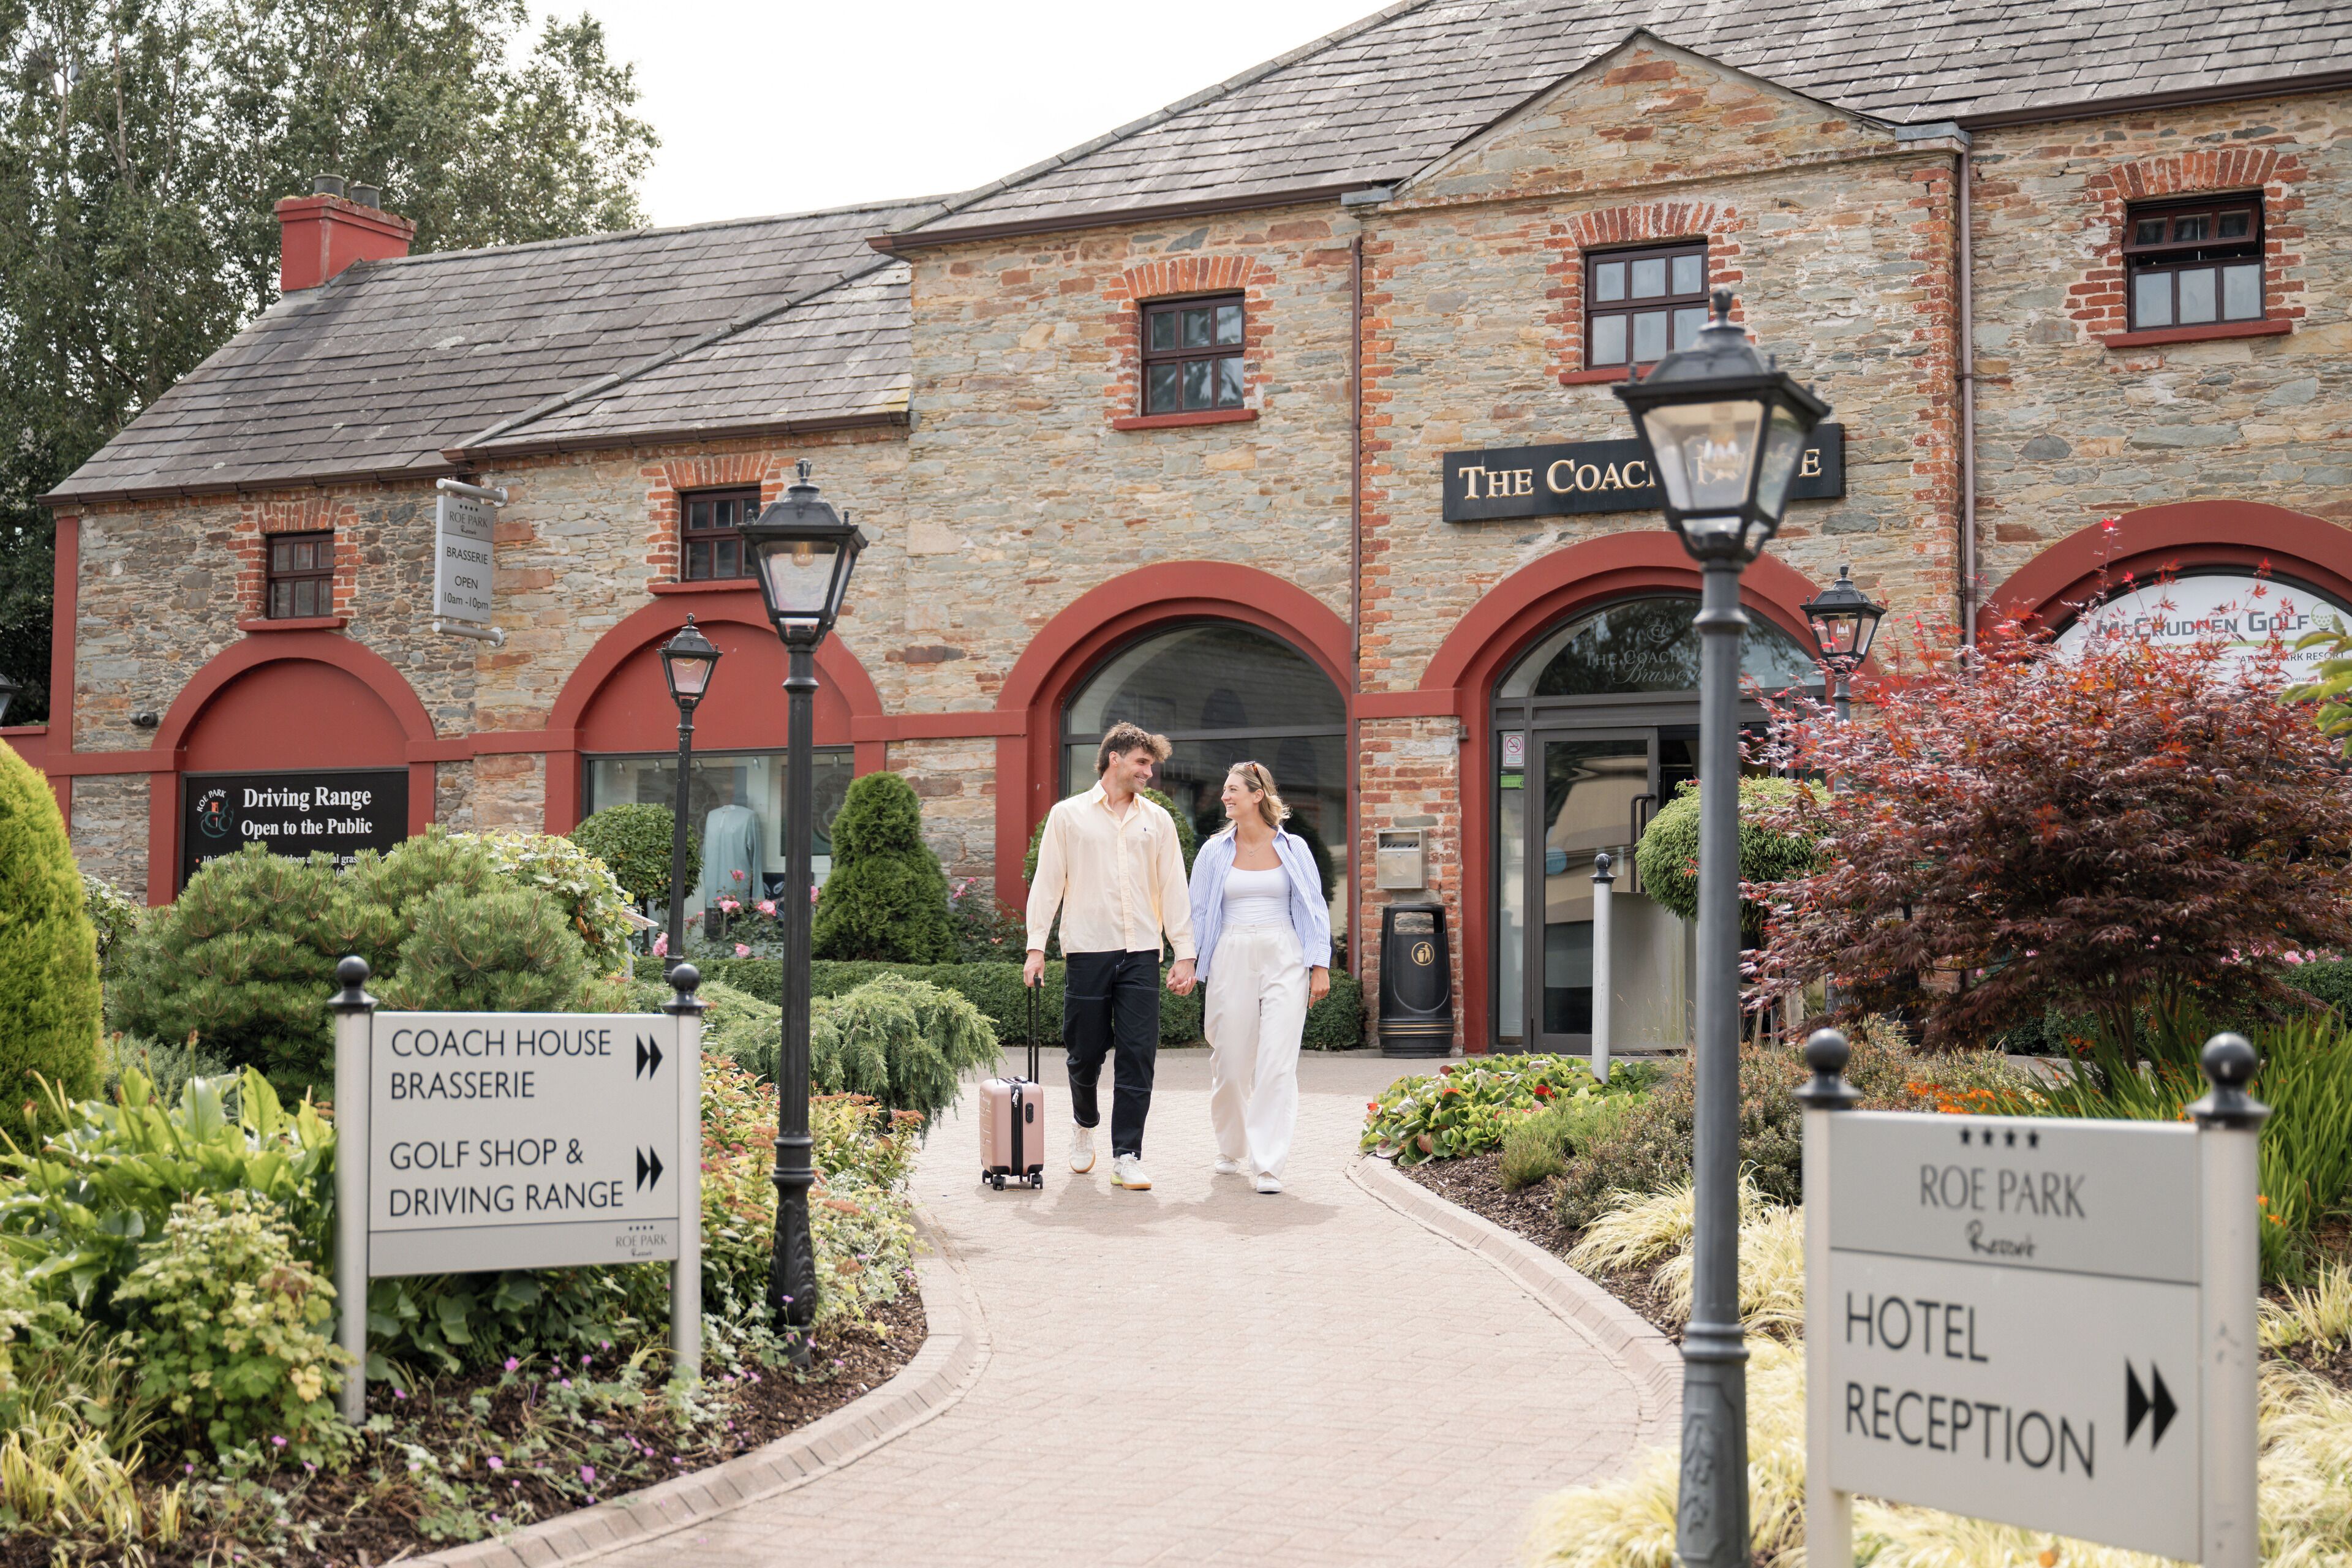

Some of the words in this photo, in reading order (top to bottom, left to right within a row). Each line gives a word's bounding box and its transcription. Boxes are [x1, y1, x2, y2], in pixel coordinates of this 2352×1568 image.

[1458, 466, 1534, 500] THE
[450, 511, 466, 524] ROE
[468, 514, 488, 528] PARK
[447, 546, 488, 565] BRASSERIE
[454, 576, 478, 589] OPEN
[444, 592, 462, 605] 10am
[2248, 611, 2309, 632] GOLF
[1623, 649, 1678, 665] COACH
[197, 795, 208, 812] ROE
[208, 789, 227, 799] PARK
[243, 788, 310, 812] Driving
[314, 786, 372, 810] Range
[241, 820, 279, 840] Open
[283, 820, 296, 835] to
[301, 820, 323, 835] the
[327, 818, 372, 834] Public
[392, 1029, 505, 1057] COACH
[516, 1029, 611, 1057] HOUSE
[391, 1071, 535, 1099] BRASSERIE
[390, 1140, 470, 1170] GOLF
[480, 1138, 557, 1167] SHOP
[566, 1138, 584, 1164] &
[390, 1183, 514, 1216] DRIVING
[526, 1180, 624, 1211] RANGE
[1920, 1164, 1986, 1212] ROE
[1998, 1168, 2086, 1219] PARK
[616, 1235, 636, 1248] ROE
[641, 1233, 667, 1246] PARK
[1846, 1291, 1989, 1363] HOTEL
[1846, 1381, 2095, 1480] RECEPTION
